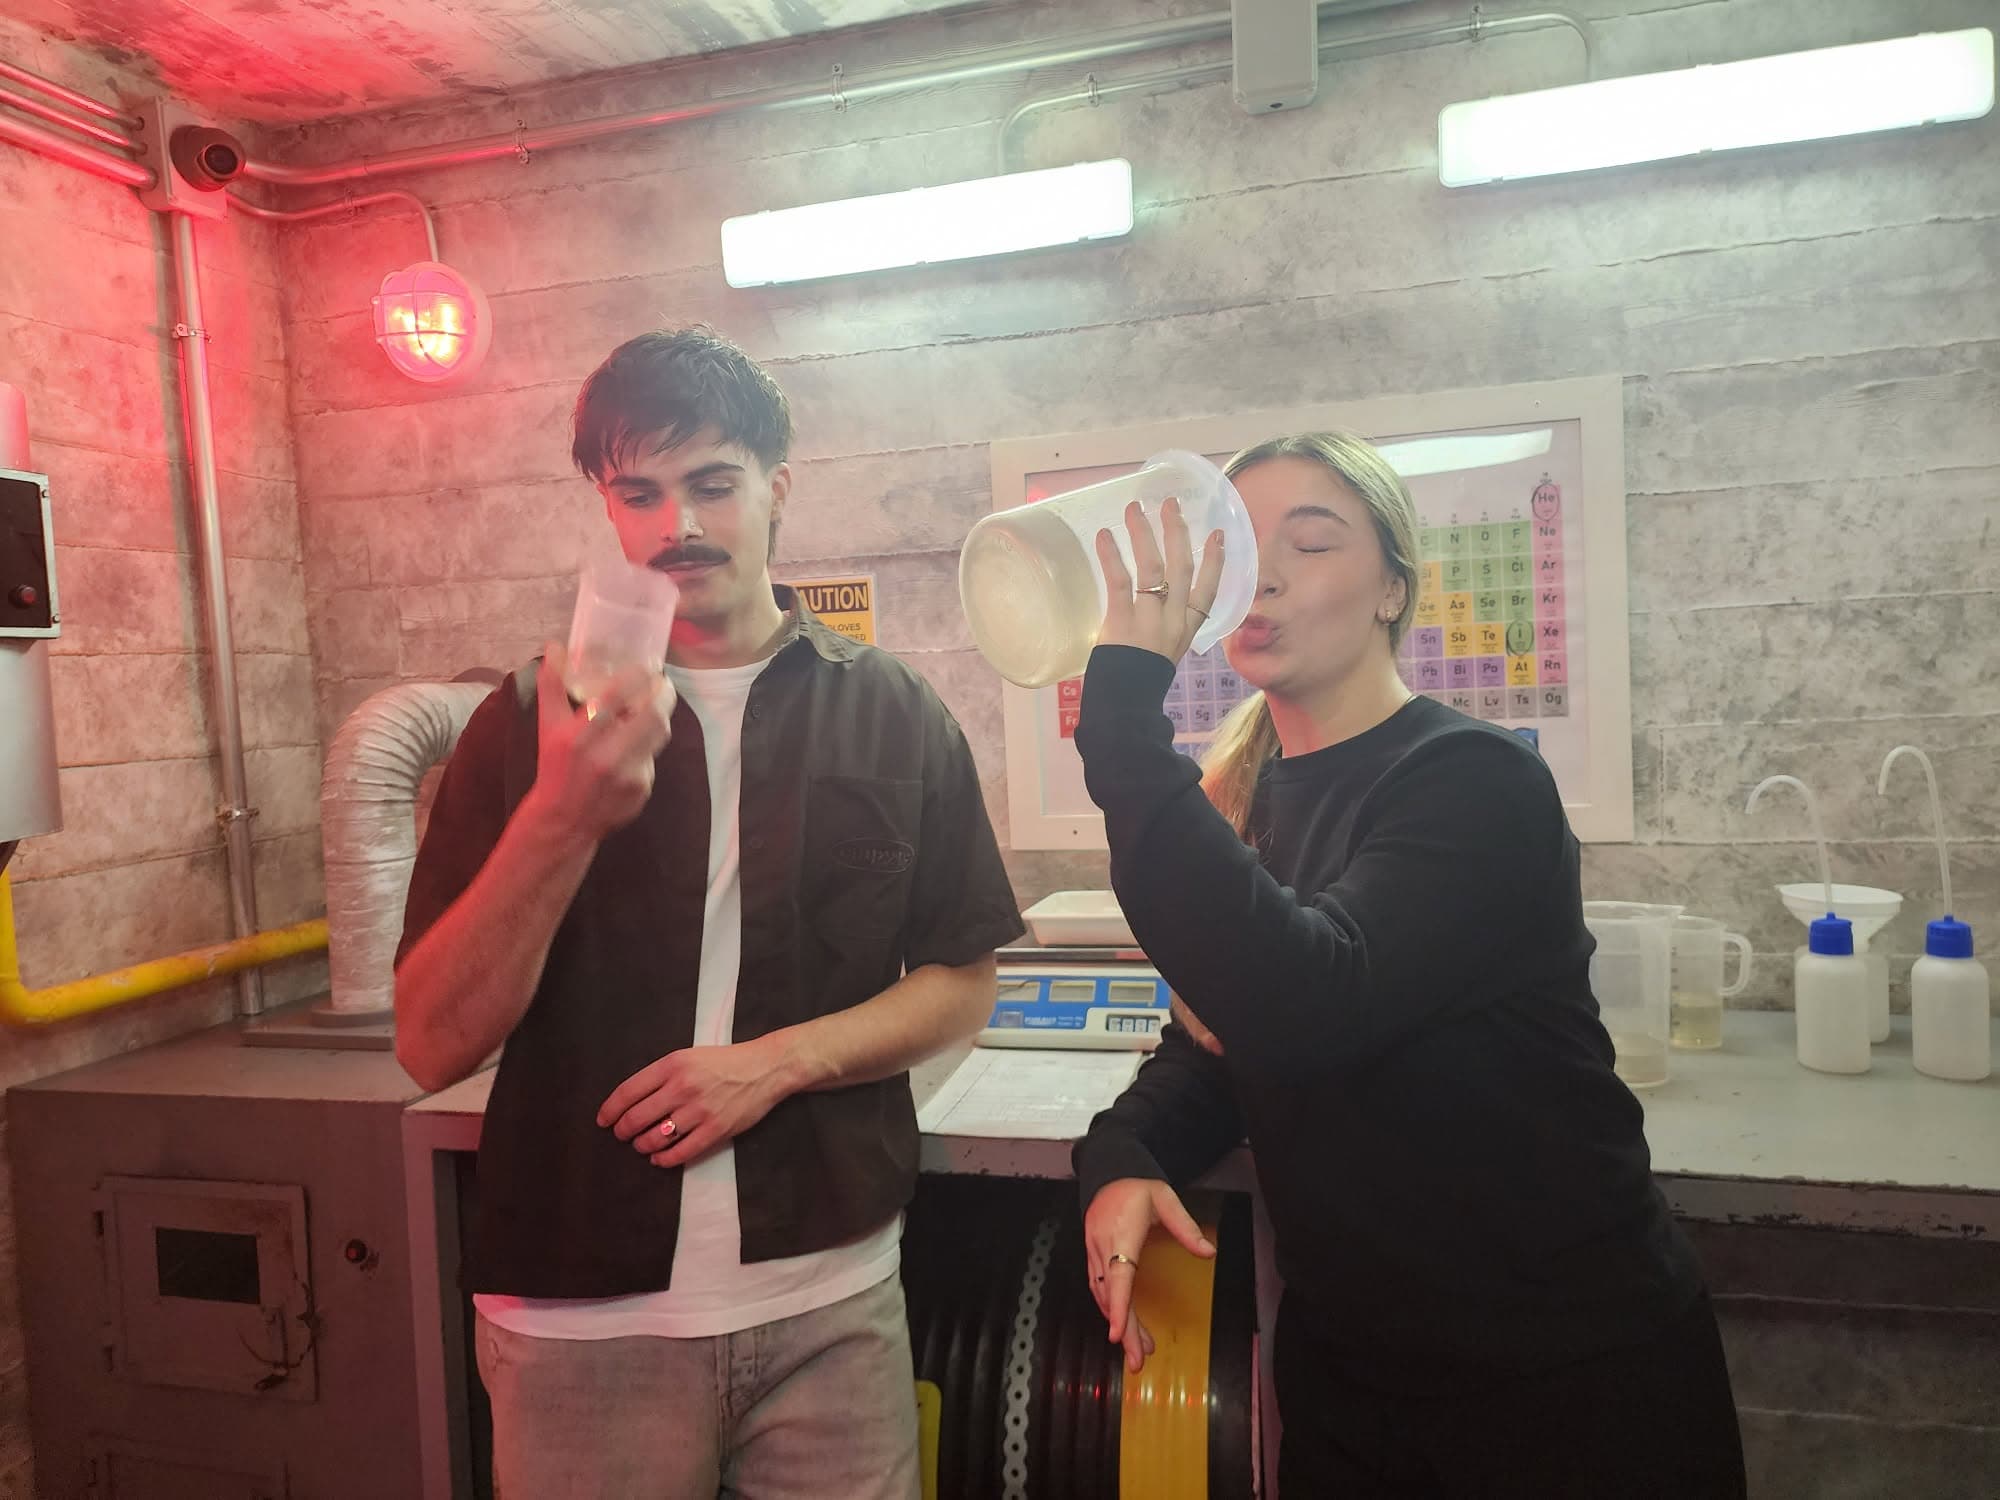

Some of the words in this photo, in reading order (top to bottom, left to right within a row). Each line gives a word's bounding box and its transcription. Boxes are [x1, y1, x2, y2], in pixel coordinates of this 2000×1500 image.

[1538, 492, 1556, 504] He
[1512, 528, 1521, 539] F
[1539, 526, 1557, 537] Ne
[1450, 533, 1460, 544] N
[1482, 563, 1491, 575] S
[1511, 561, 1524, 573] Cl
[1541, 560, 1557, 571] Ar
[1452, 566, 1461, 577] P
[799, 586, 867, 611] AUTION
[1480, 597, 1496, 608] Se
[1511, 595, 1526, 606] Br
[1542, 593, 1558, 604] Kr
[1449, 600, 1465, 610] As
[827, 623, 861, 632] LOVES
[1543, 626, 1559, 637] Xe
[1420, 634, 1436, 645] Sn
[1451, 632, 1467, 643] Sb
[1482, 630, 1496, 641] Te
[1454, 664, 1466, 675] Bi
[1483, 662, 1498, 673] Po
[1514, 661, 1528, 672] At
[1544, 660, 1561, 671] Rn
[1422, 666, 1438, 677] Pb
[1195, 679, 1206, 689] W
[1221, 677, 1235, 688] Re
[1452, 697, 1471, 708] Mc
[1484, 696, 1499, 706] Lv
[1516, 694, 1530, 705] Ts
[1544, 692, 1562, 705] Og
[1195, 709, 1210, 722] Sg
